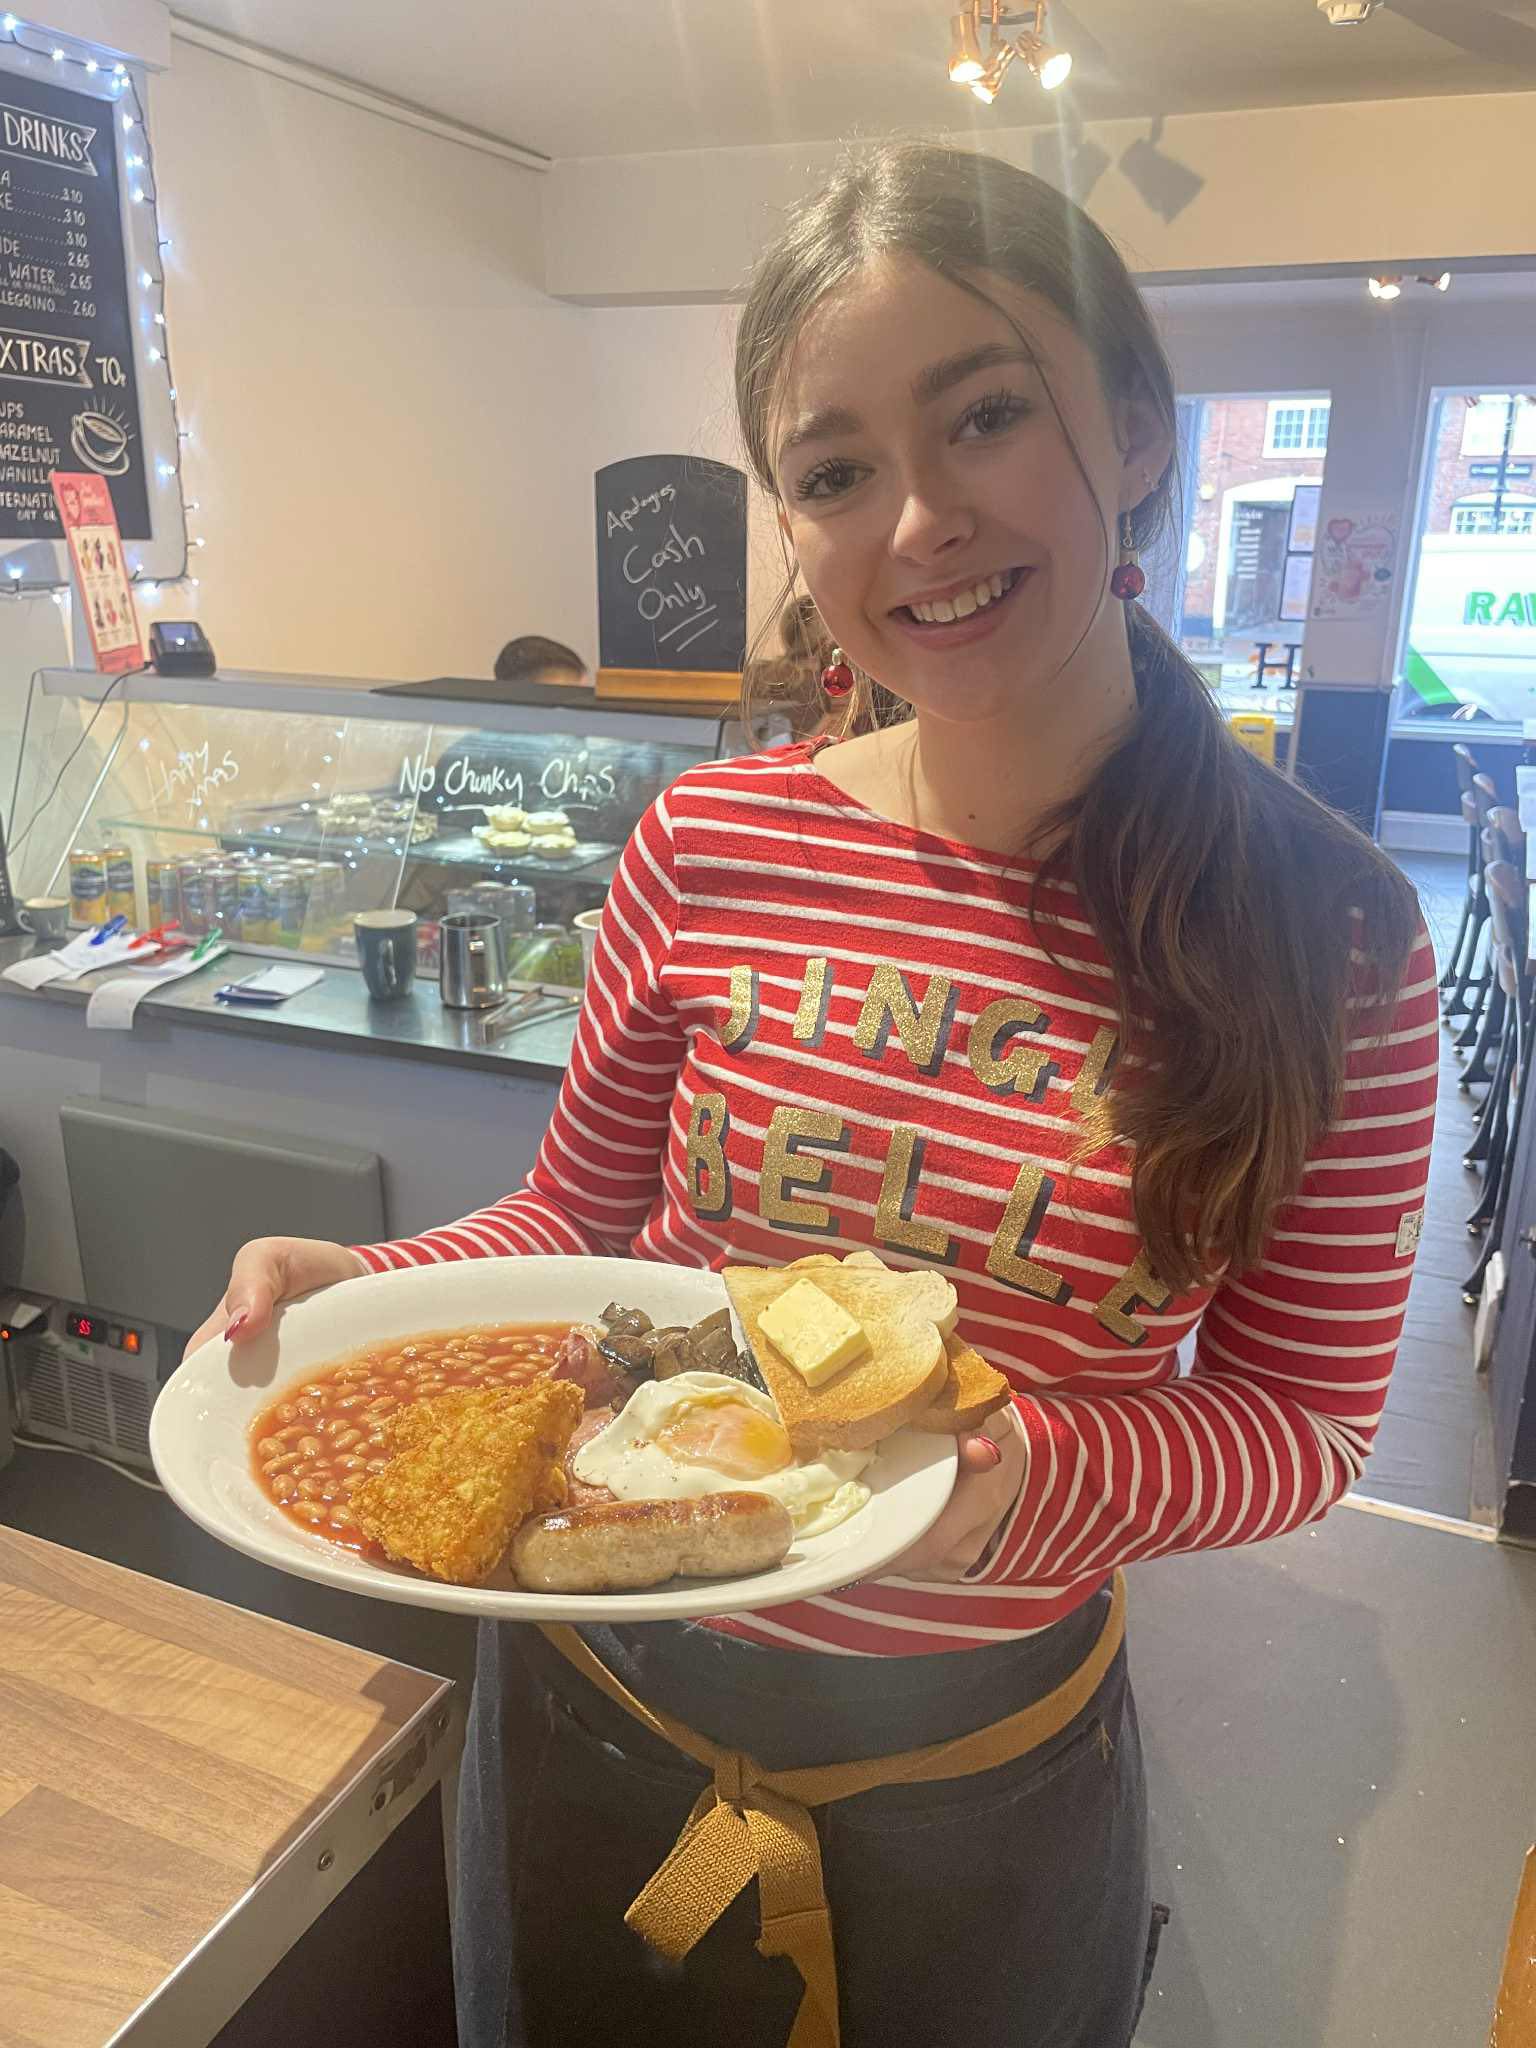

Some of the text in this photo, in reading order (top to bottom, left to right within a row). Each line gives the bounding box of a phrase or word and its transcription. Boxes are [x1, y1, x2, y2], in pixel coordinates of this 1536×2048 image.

[3, 111, 84, 161] DRINKS
[8, 262, 56, 286] WATER
[622, 523, 705, 583] Cash
[638, 582, 706, 620] Only
[1464, 591, 1536, 626] RA
[400, 751, 615, 802] No Chunky Chips
[720, 957, 1122, 1116] JINGL
